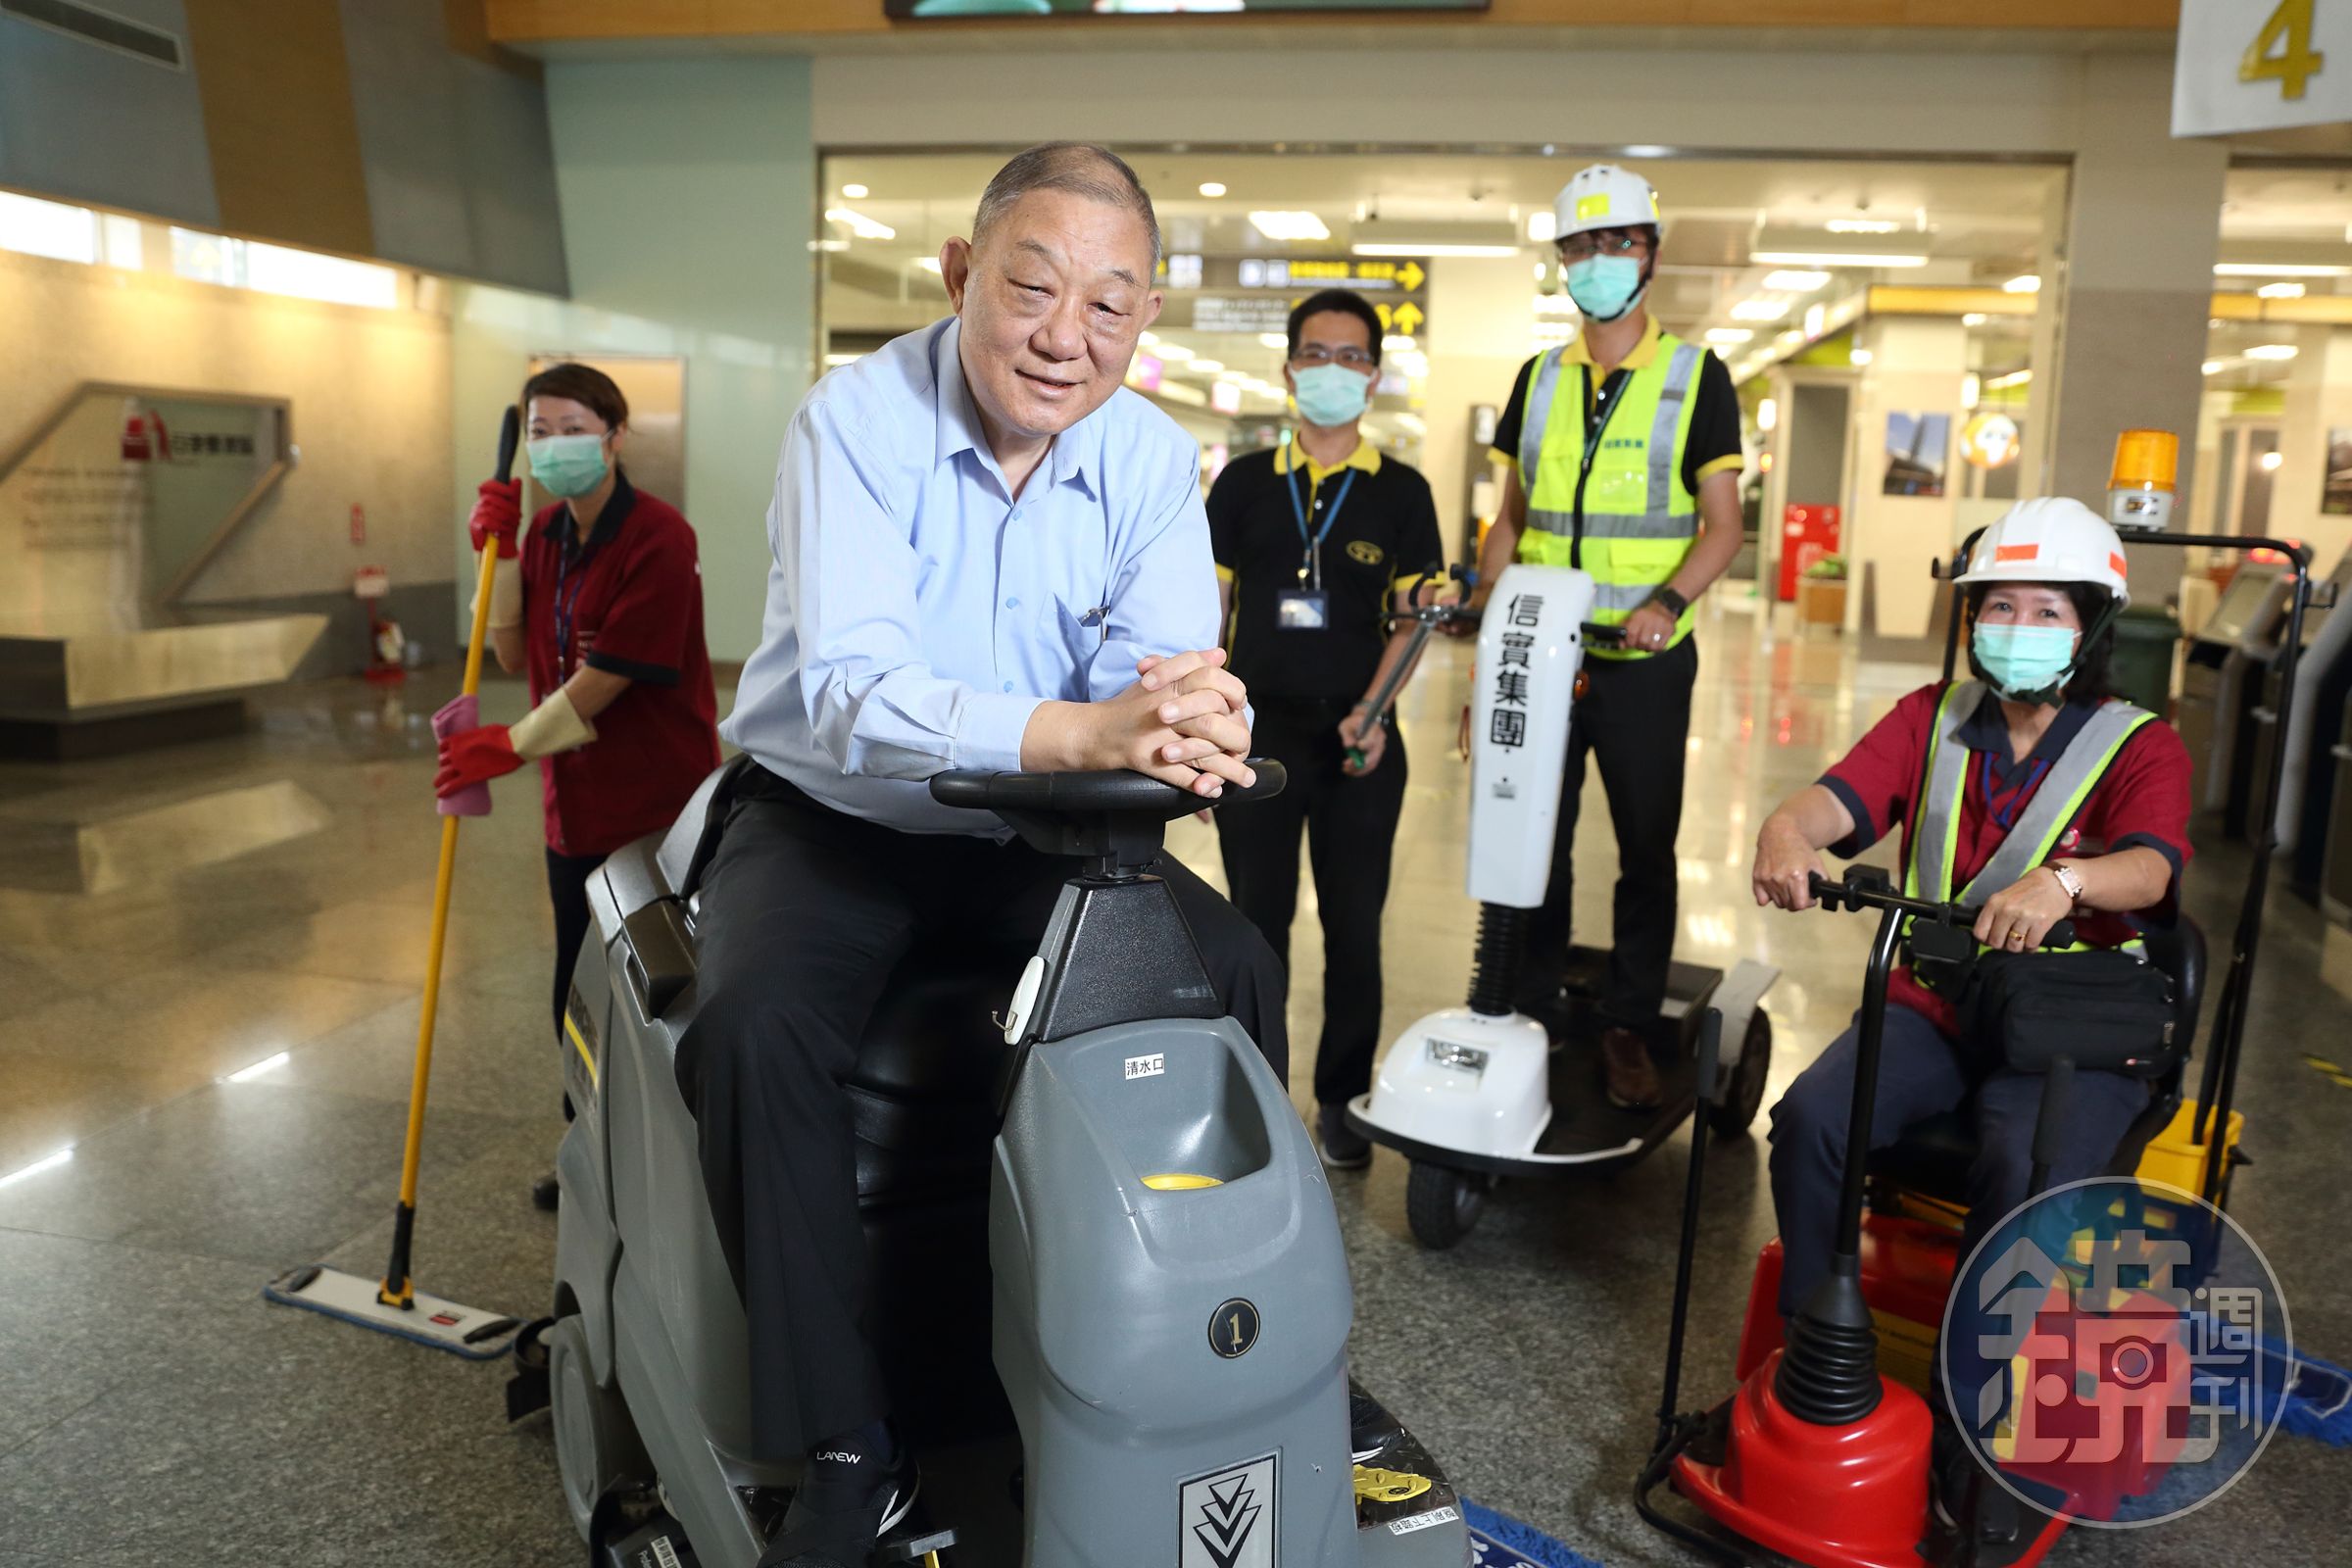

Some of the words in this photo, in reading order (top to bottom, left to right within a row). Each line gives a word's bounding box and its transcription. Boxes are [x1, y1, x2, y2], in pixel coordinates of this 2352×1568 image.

[2238, 0, 2325, 101] 4
[1491, 594, 1544, 748] 信實集團
[1126, 1058, 1164, 1076] 清水口
[1230, 1313, 1244, 1346] 1
[816, 1451, 861, 1464] LANEW
